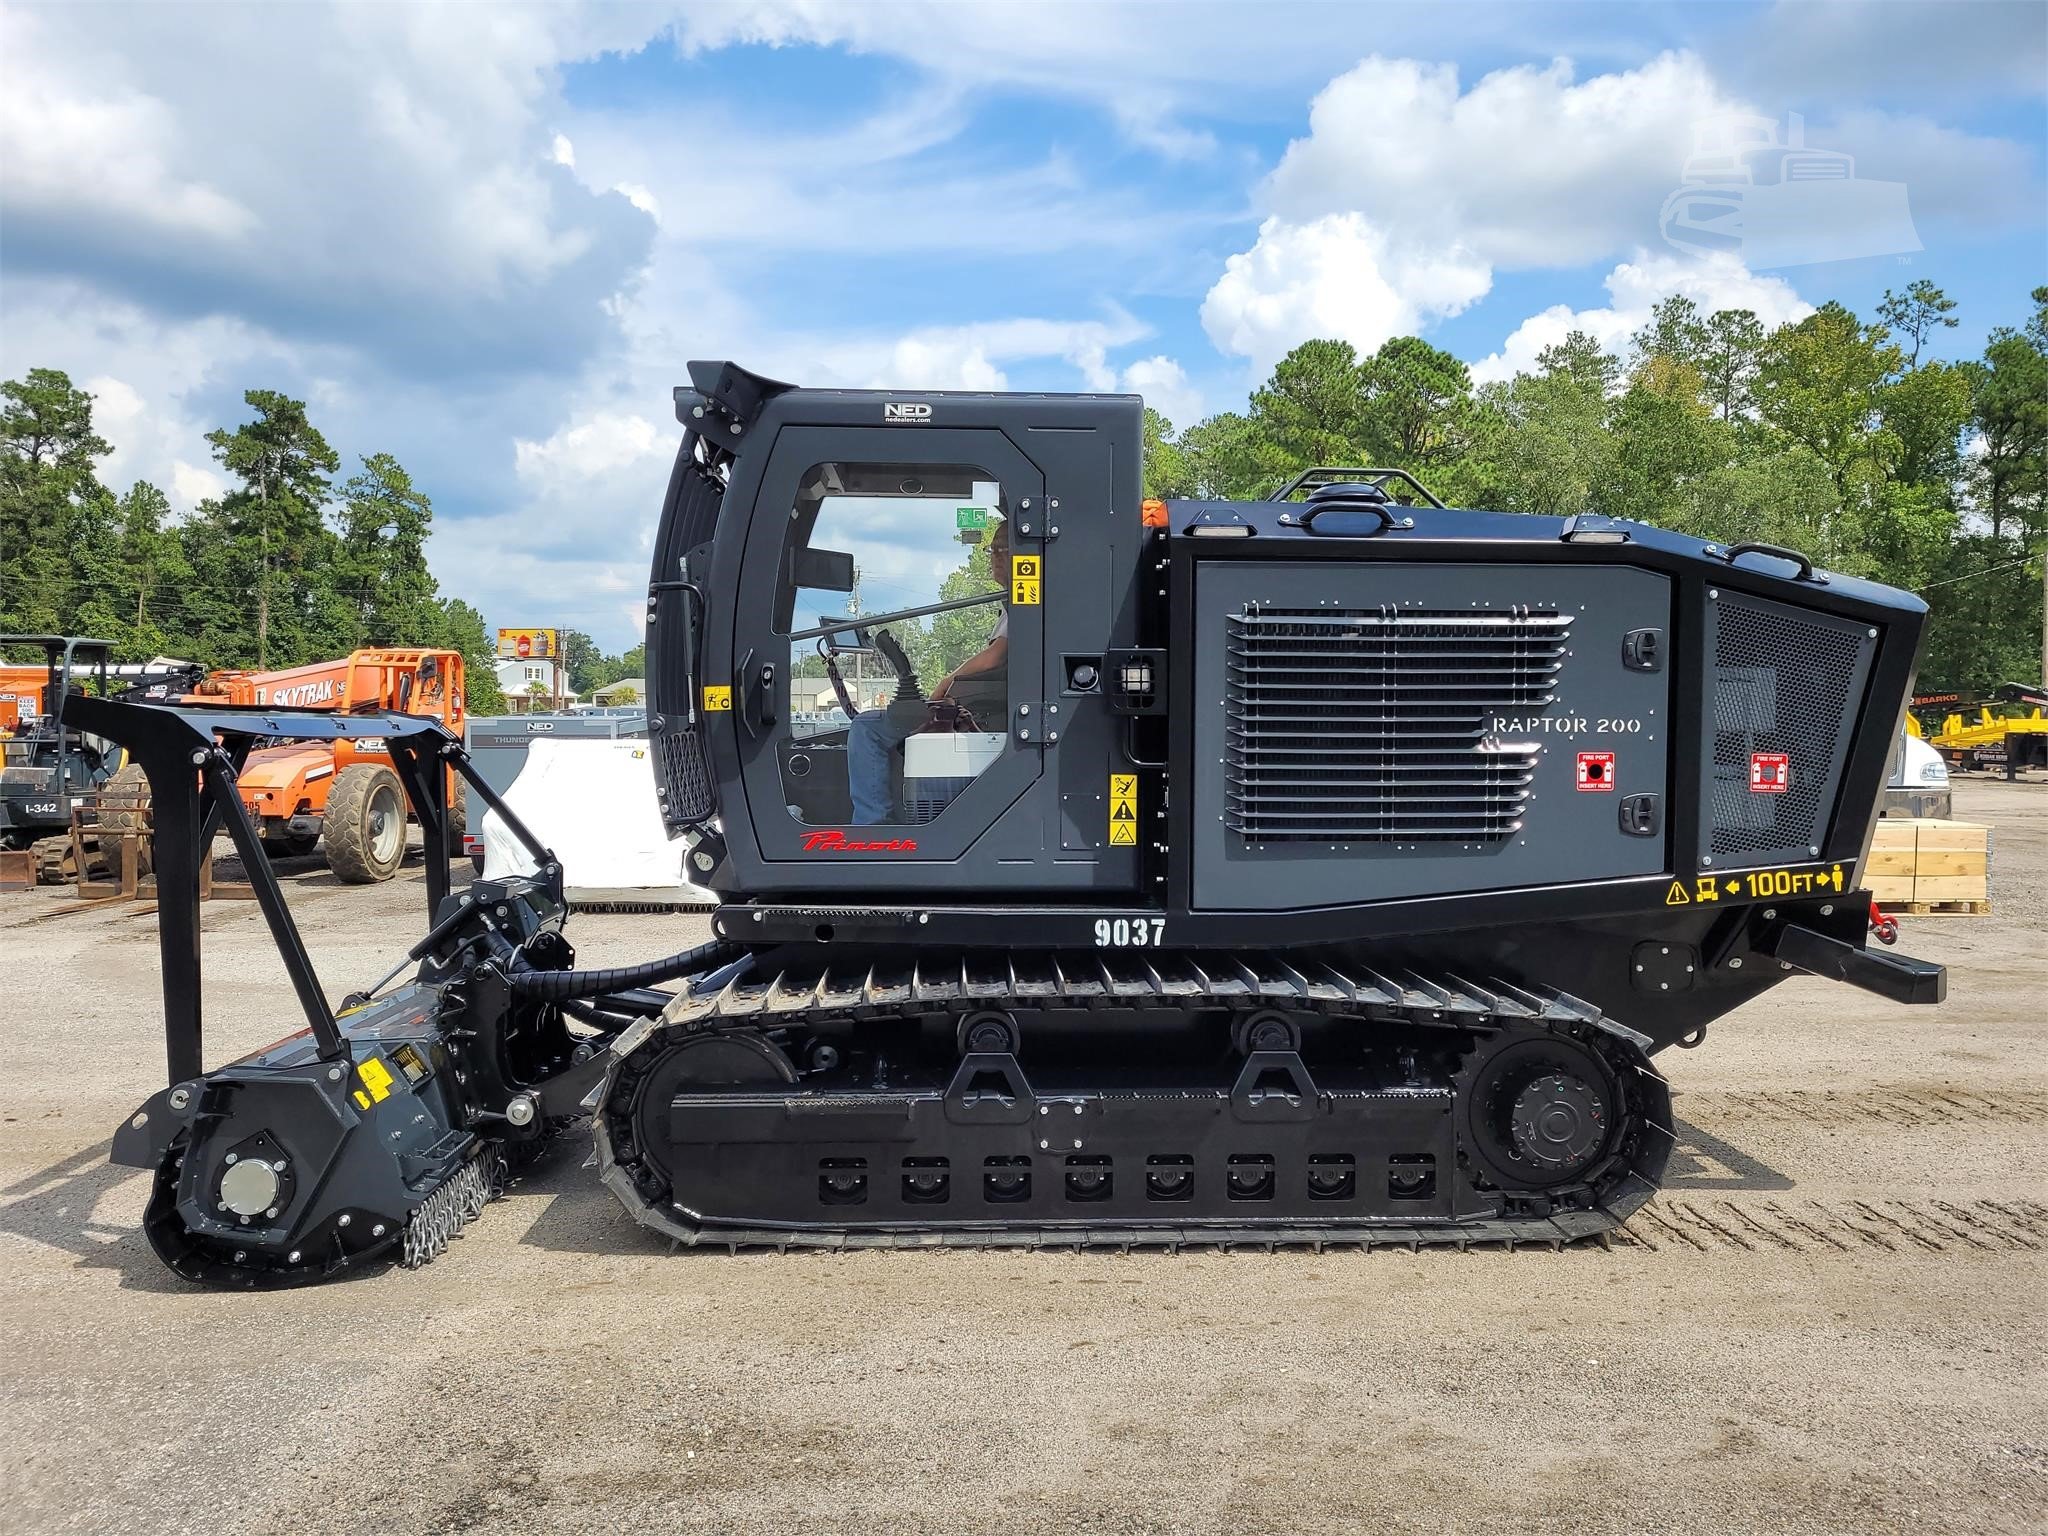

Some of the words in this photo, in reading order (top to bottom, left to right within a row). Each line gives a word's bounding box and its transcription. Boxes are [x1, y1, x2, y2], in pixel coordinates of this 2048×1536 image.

[884, 402, 933, 417] NED
[273, 680, 334, 706] SKYTRAK
[1921, 694, 1958, 704] BARKO
[527, 722, 554, 731] NED
[1493, 717, 1588, 733] RAPTOR
[1597, 718, 1641, 733] 200
[25, 803, 57, 813] I-342
[800, 831, 917, 851] Prinoth
[1746, 871, 1813, 897] 100FT
[1094, 918, 1166, 947] 9037
